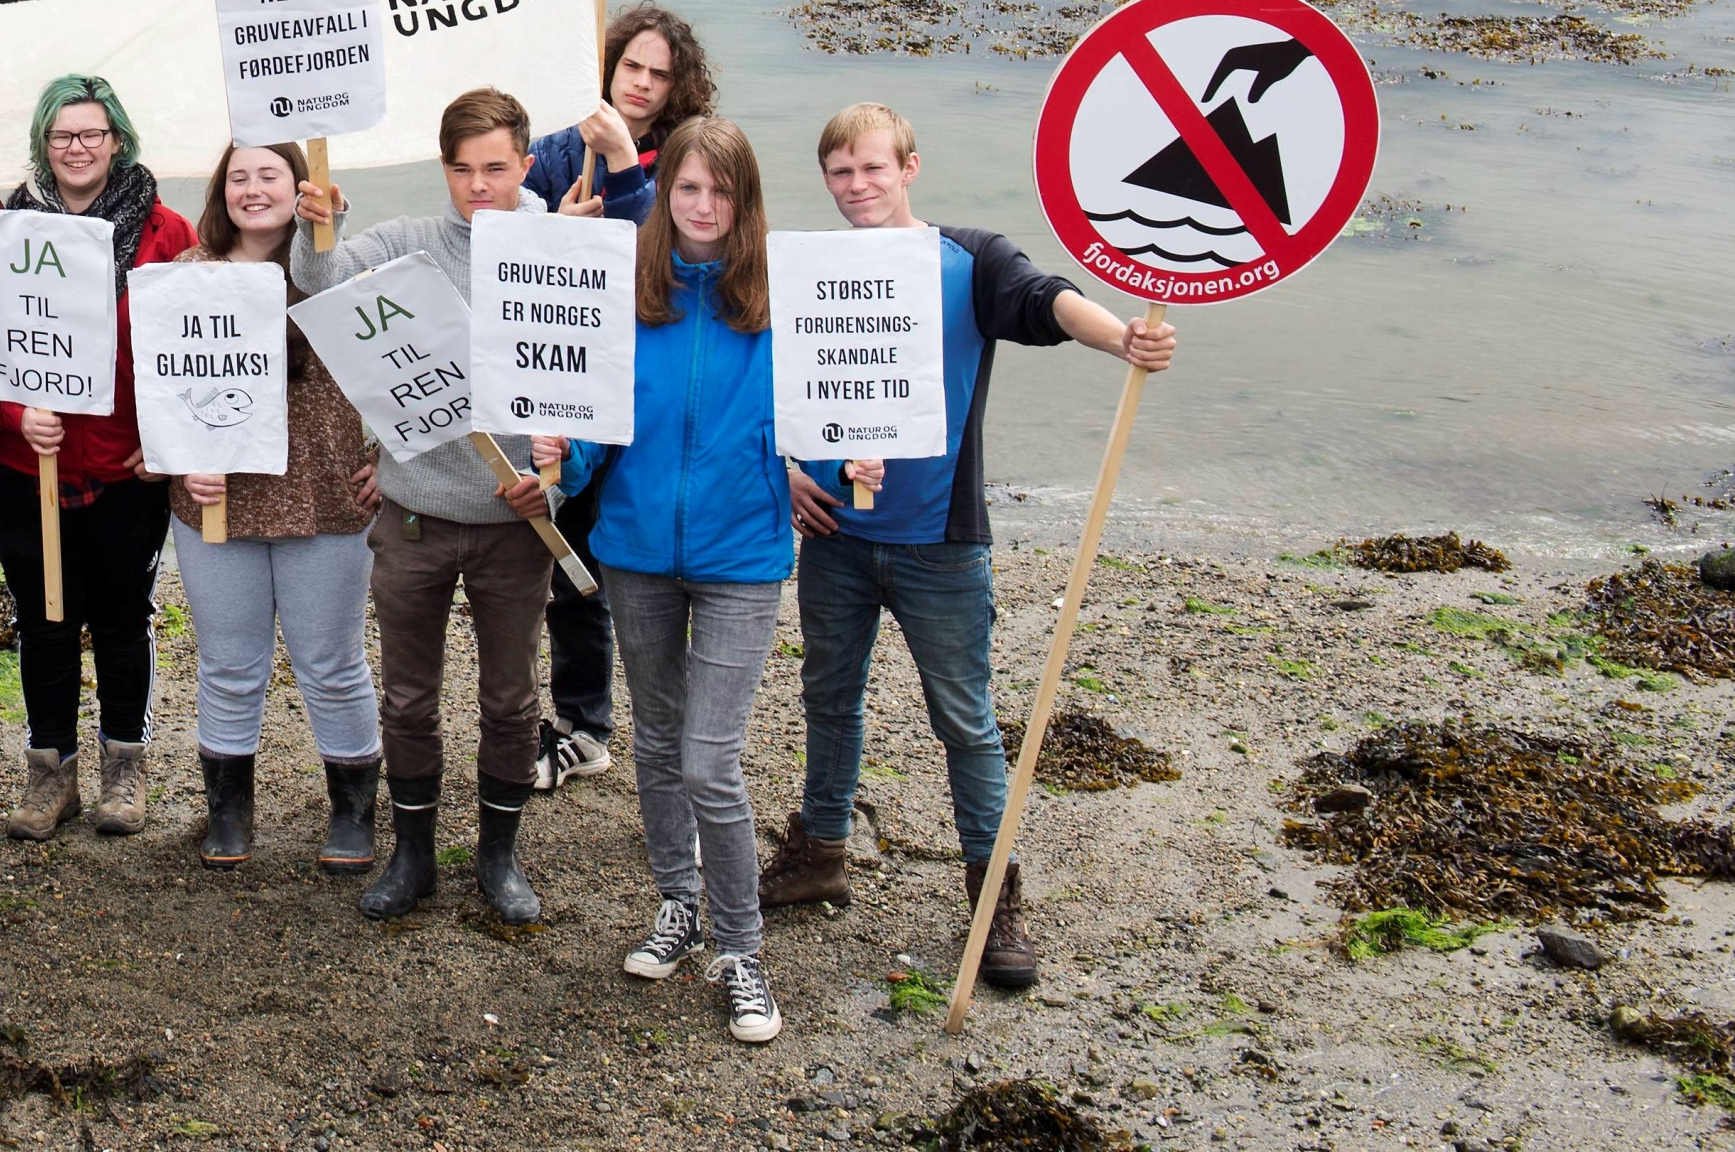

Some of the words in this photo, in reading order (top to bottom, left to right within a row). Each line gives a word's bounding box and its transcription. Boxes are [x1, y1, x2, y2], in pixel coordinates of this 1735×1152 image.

[234, 14, 357, 45] GRUVEAVFALL
[362, 9, 368, 28] I
[239, 44, 370, 79] FØRDEFJORDEN
[297, 95, 332, 106] NATUR
[334, 92, 349, 101] OG
[298, 99, 349, 113] UNGDOM
[10, 239, 66, 278] JA
[1082, 242, 1280, 297] fjordaksjonen.org
[498, 262, 607, 290] GRUVESLAM
[816, 280, 895, 301] STØRSTE
[19, 295, 58, 319] TIL
[354, 295, 415, 341] JA
[502, 301, 525, 322] ER
[531, 303, 601, 328] NORGES
[182, 315, 203, 338] JA
[209, 315, 241, 338] TIL
[795, 316, 918, 334] FORURENSINGS-
[7, 329, 73, 359] REN
[817, 347, 897, 365] SKANDALE
[157, 354, 269, 377] GLADLAKS!
[381, 344, 431, 369] TIL
[515, 341, 587, 374] SKAM
[390, 361, 466, 408] REN
[807, 381, 811, 400] I
[818, 380, 876, 400] NYERE
[881, 379, 910, 398] TID
[394, 393, 472, 442] FJOR
[539, 402, 576, 412] NATUR
[578, 405, 594, 413] OG
[539, 410, 594, 421] UNGDOM
[848, 432, 897, 441] UNGDOM
[883, 425, 897, 433] OG
